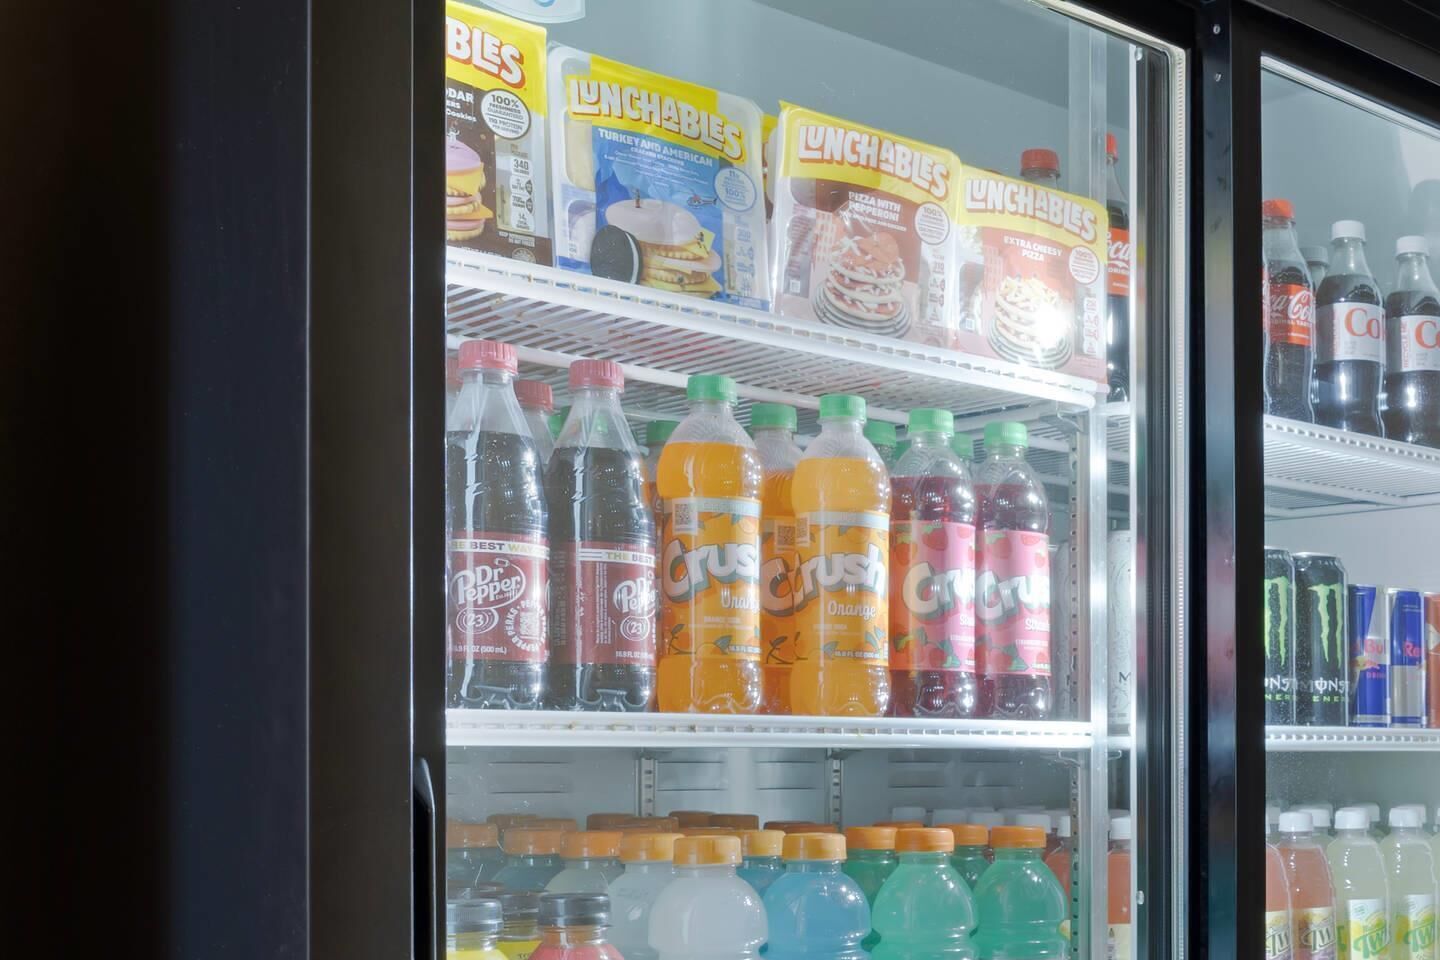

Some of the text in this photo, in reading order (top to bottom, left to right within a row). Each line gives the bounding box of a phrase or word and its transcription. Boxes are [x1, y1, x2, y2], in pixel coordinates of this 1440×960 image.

[491, 94, 520, 109] 100%
[569, 78, 743, 160] LUNCHABLES
[598, 128, 713, 167] TURKEY AND AMERICAN
[799, 125, 949, 200] LUNCHABLES
[848, 191, 875, 204] PIZZA
[965, 177, 1098, 244] LUNCHABLES
[1003, 235, 1063, 257] EXTRA CHEESY
[457, 570, 521, 606] Pepper
[475, 565, 504, 586] Dr
[827, 600, 877, 620] Orange
